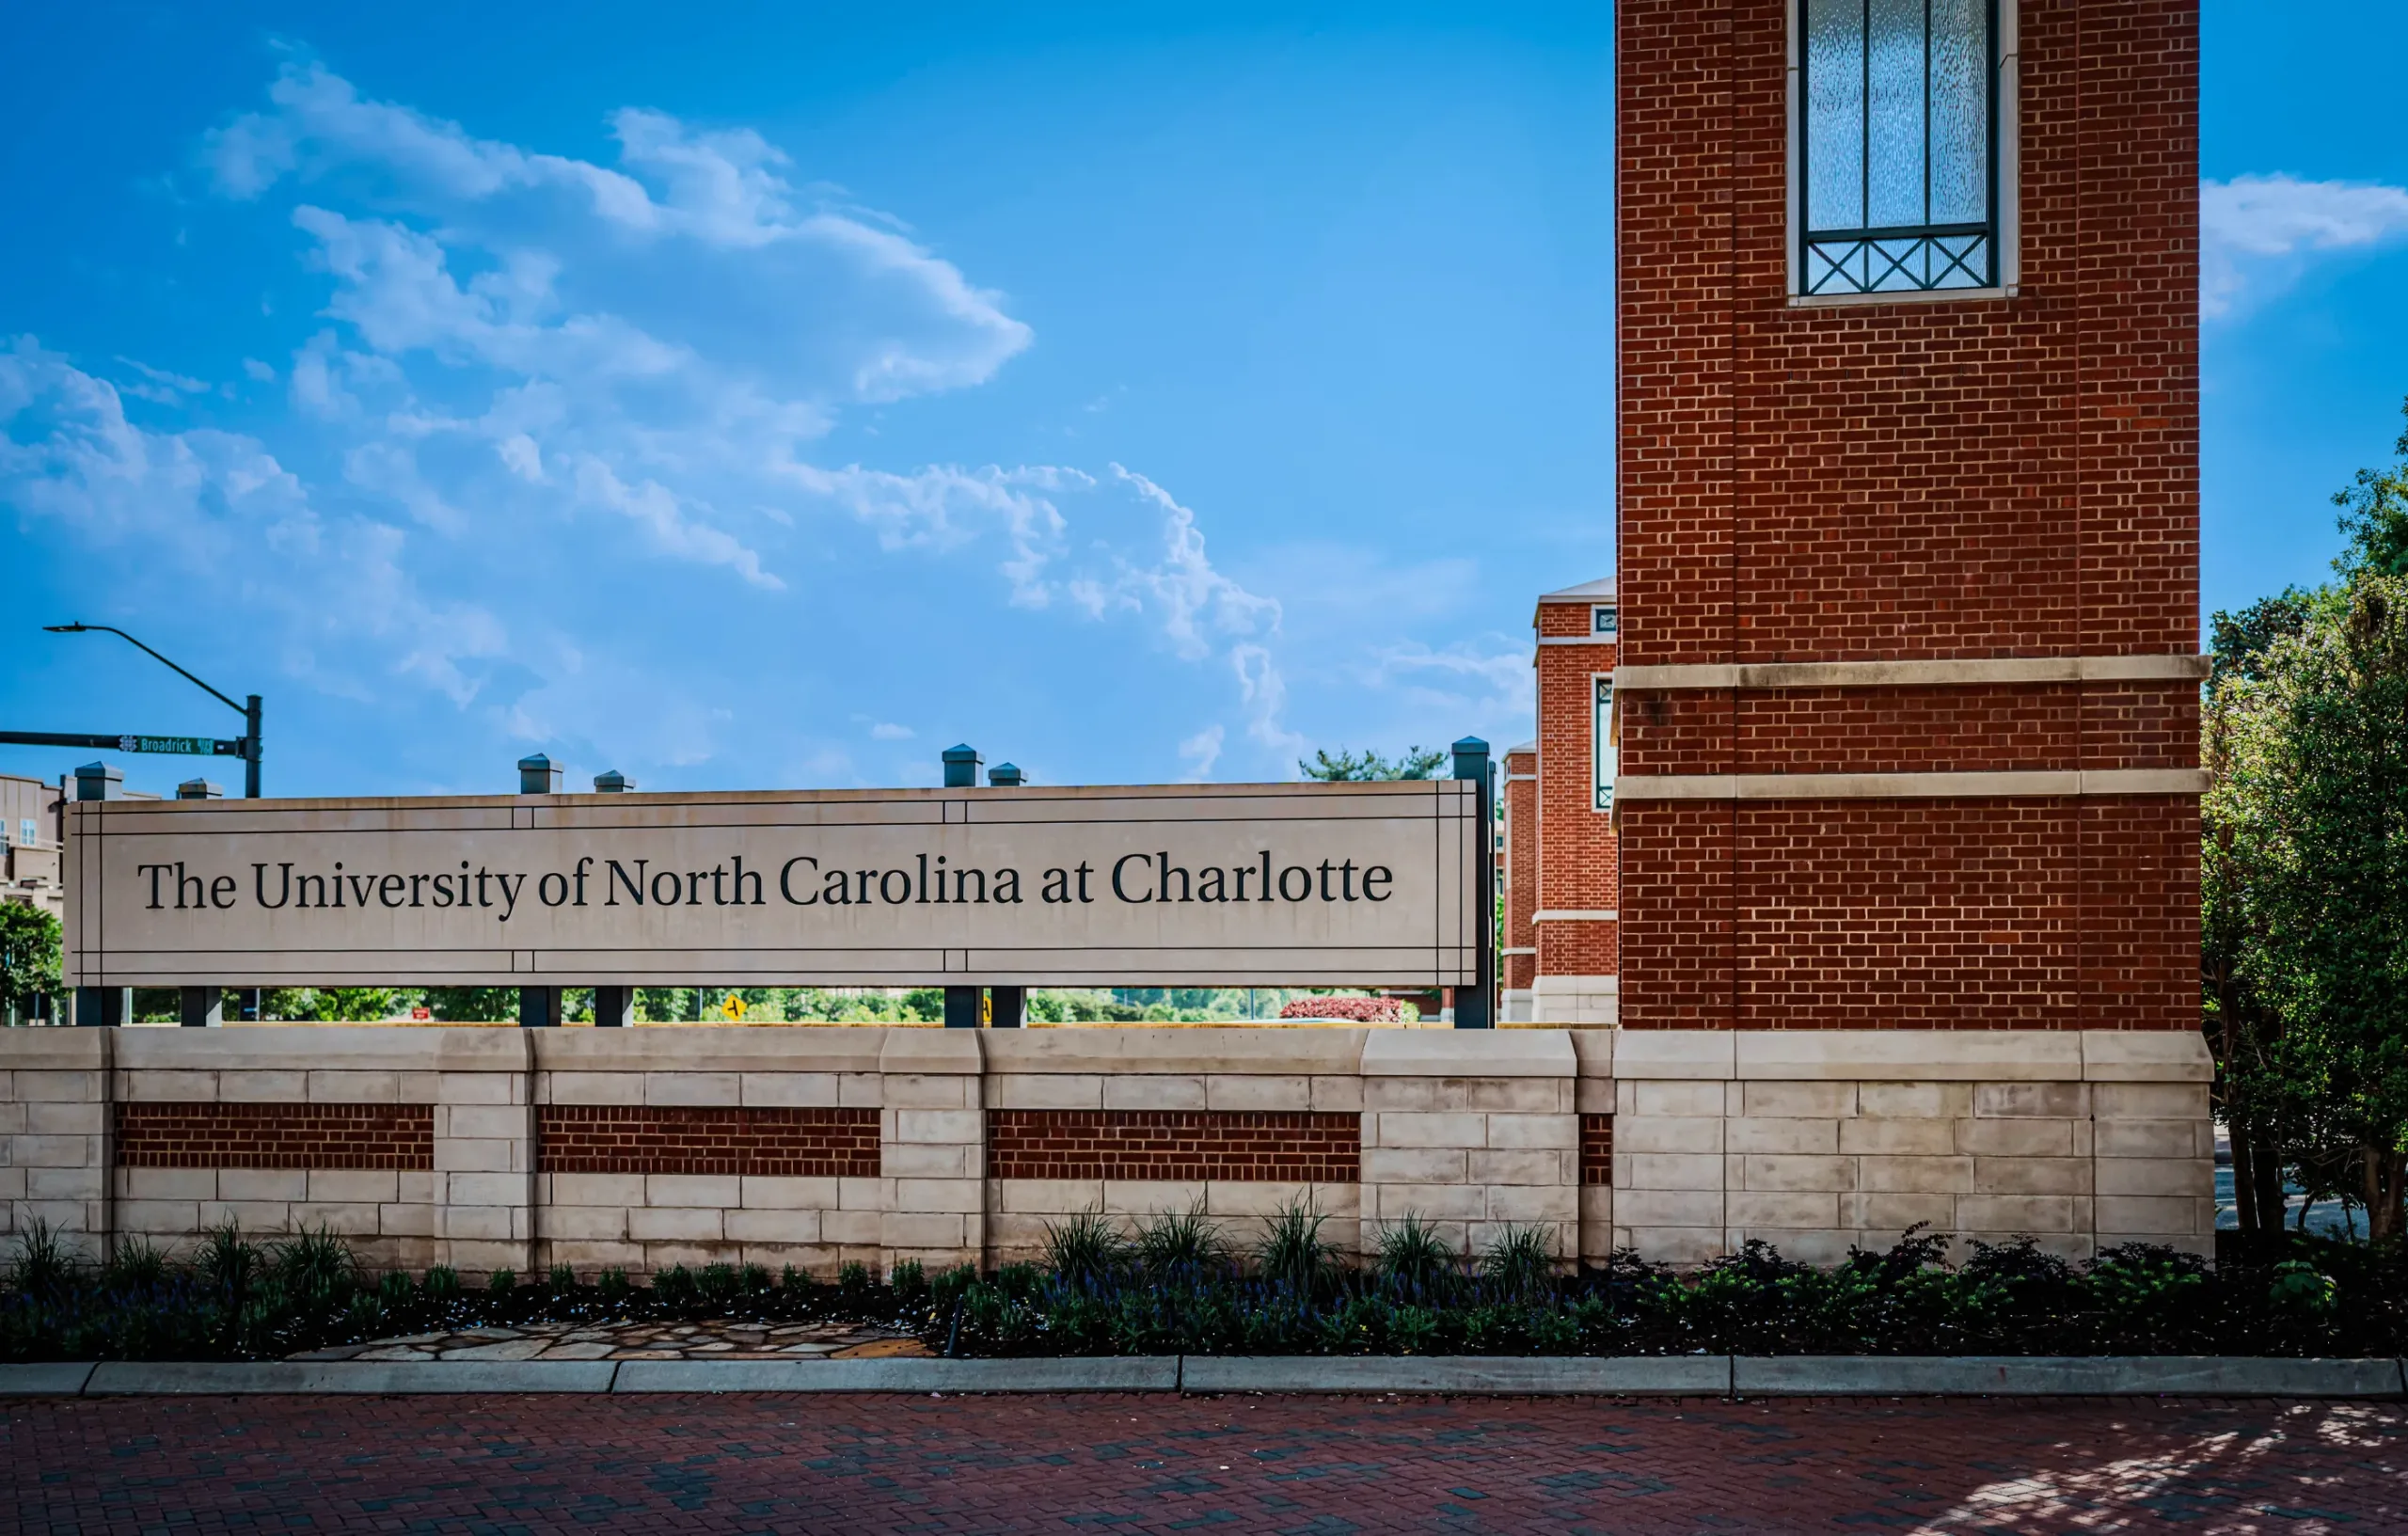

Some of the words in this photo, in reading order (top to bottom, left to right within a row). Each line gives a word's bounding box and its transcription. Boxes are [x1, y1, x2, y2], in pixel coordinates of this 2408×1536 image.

[141, 737, 192, 753] Broadrick
[136, 861, 237, 911] The
[250, 860, 528, 923] University
[538, 856, 594, 908] of
[604, 854, 767, 907] North
[780, 852, 1024, 906] Carolina
[1041, 860, 1095, 904] at
[1111, 849, 1394, 904] Charlotte
